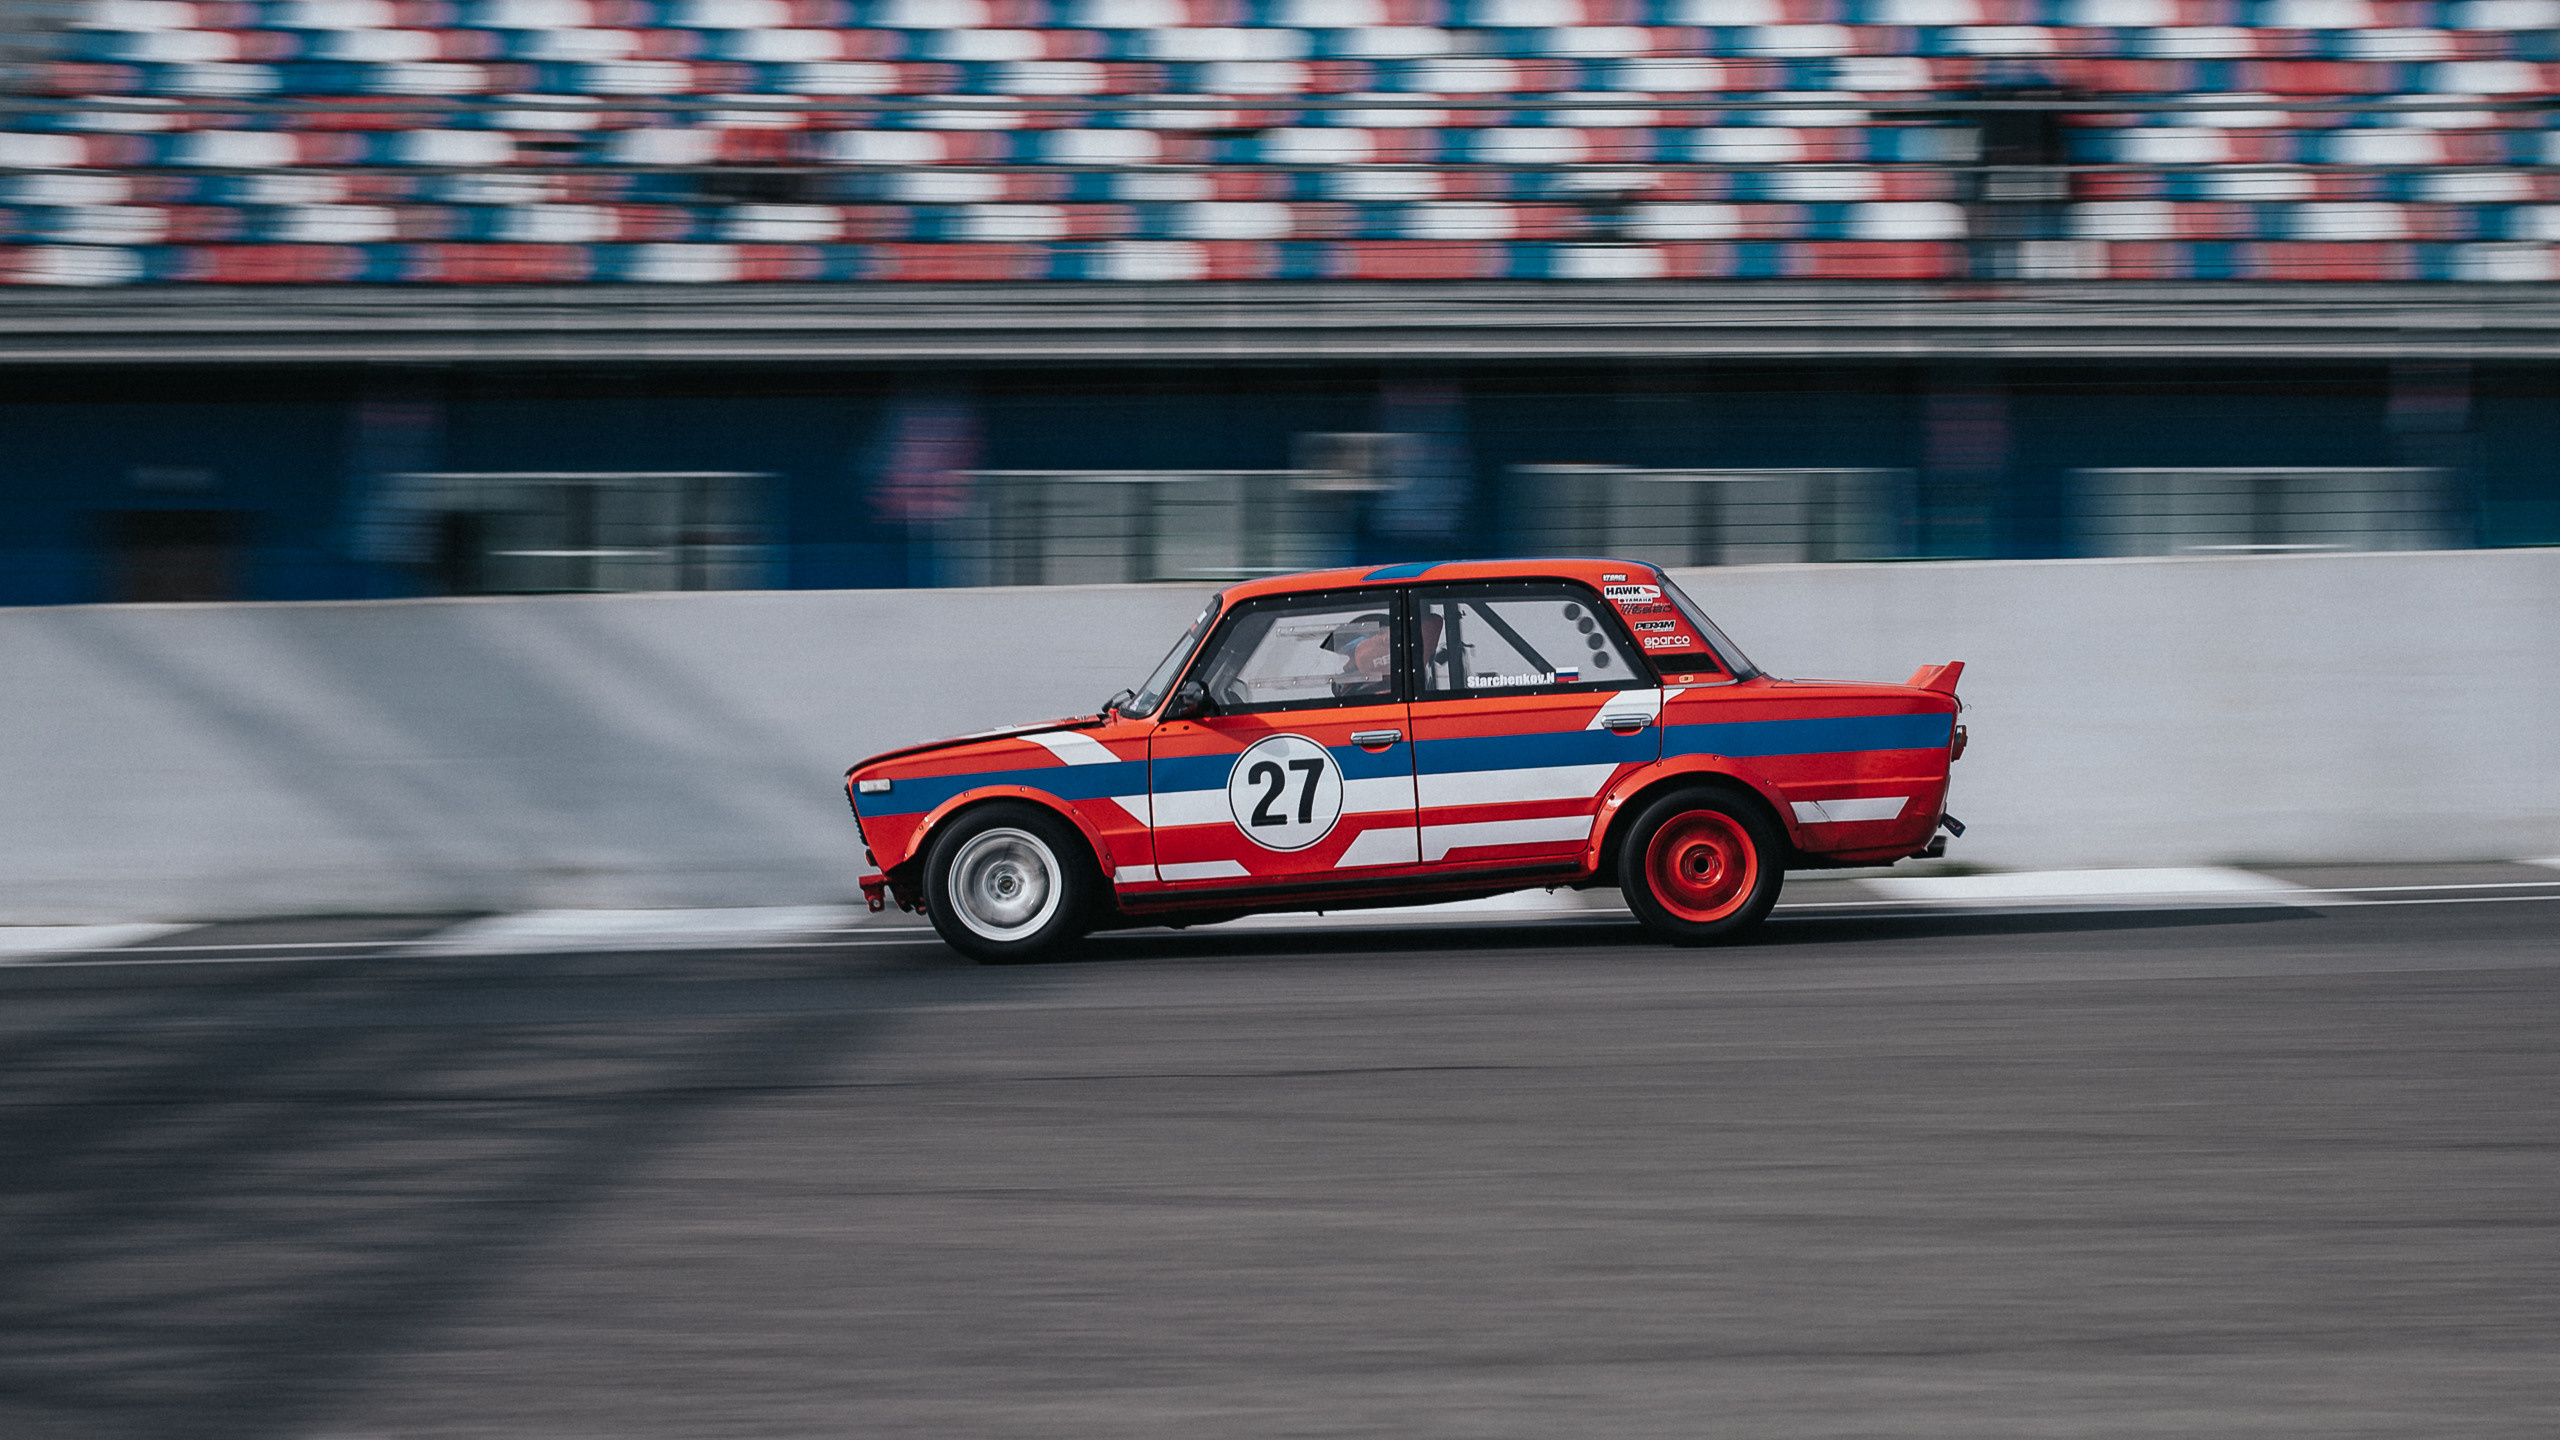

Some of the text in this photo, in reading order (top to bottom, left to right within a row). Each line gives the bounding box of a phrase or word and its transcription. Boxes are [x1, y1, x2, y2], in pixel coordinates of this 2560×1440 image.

[1606, 586, 1641, 596] HAWK
[1644, 635, 1690, 649] sparco
[1467, 672, 1555, 688] Starchenkov.N
[1248, 758, 1325, 828] 27
